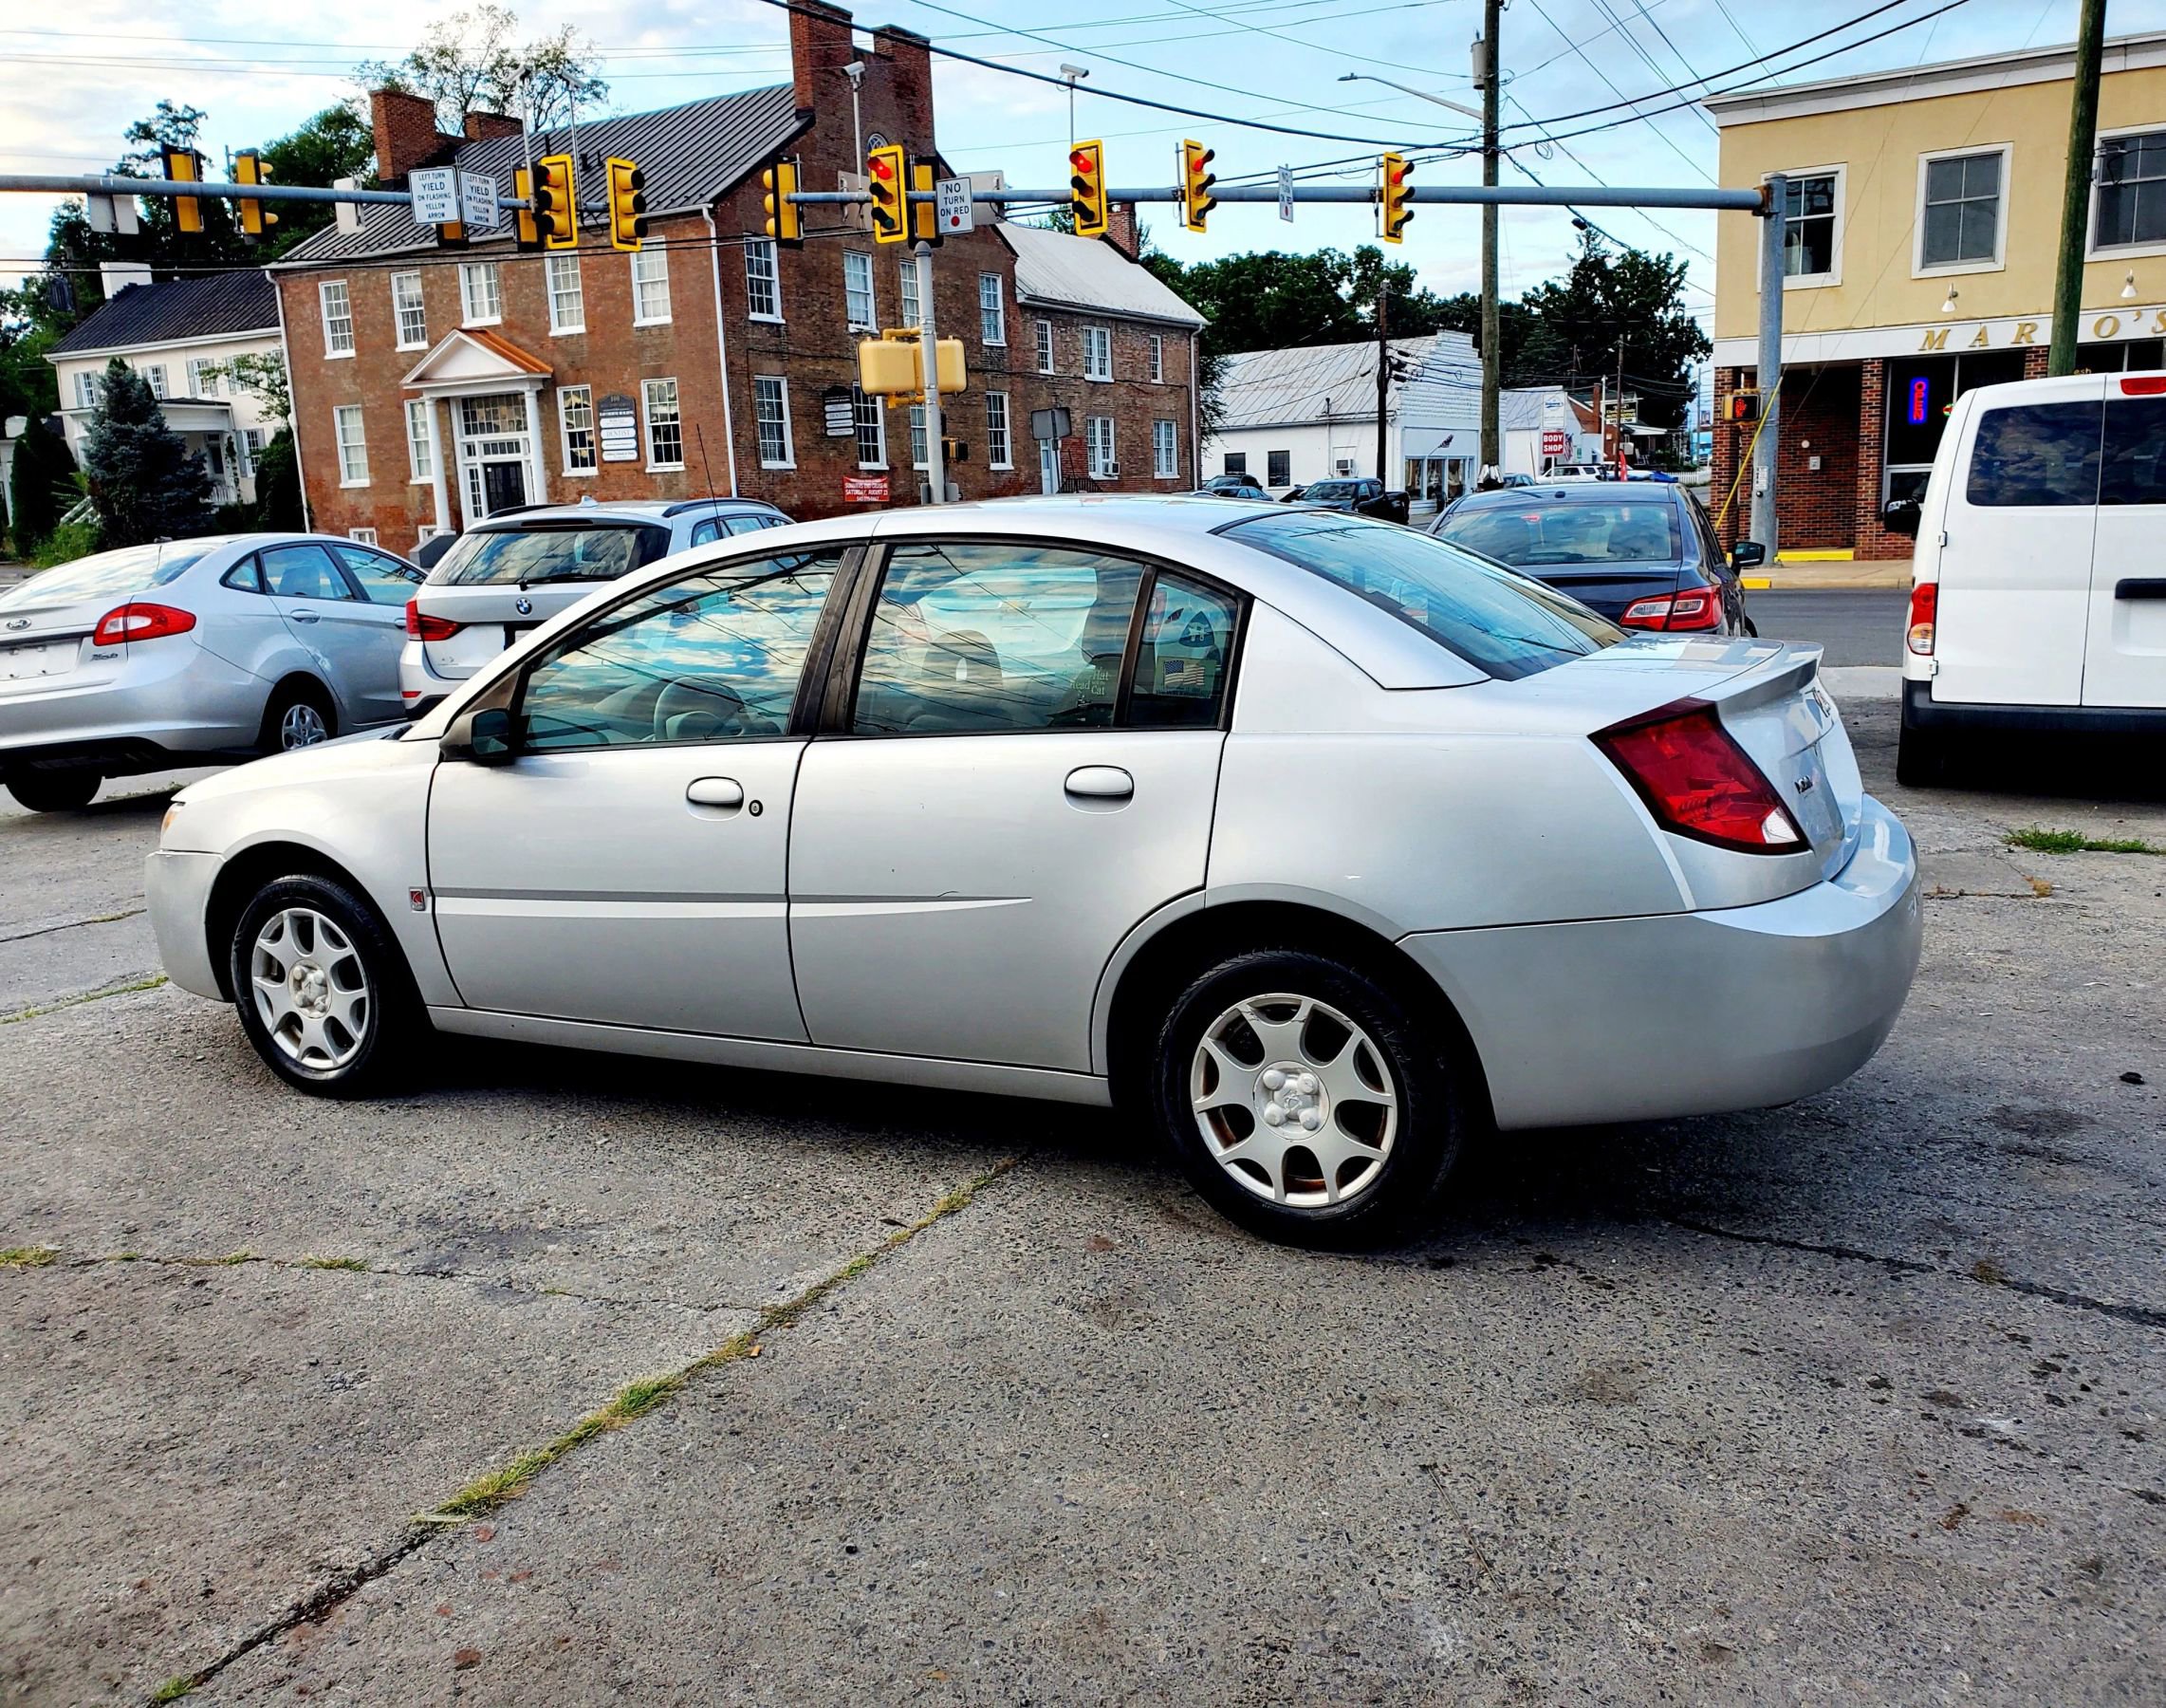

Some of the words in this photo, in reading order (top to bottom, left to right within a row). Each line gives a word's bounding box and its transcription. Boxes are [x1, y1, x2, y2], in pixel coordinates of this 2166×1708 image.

[421, 181, 445, 191] YIELD
[470, 184, 490, 195] YIELD
[945, 182, 961, 195] NO
[426, 192, 451, 200] FLASHING
[472, 196, 494, 206] FLASHING
[943, 195, 964, 205] TURN
[425, 202, 445, 211] YELLOW
[472, 205, 489, 214] YELLOW
[940, 208, 952, 217] ON
[953, 205, 970, 215] RED
[1918, 310, 2166, 351] MARO'S
[1913, 381, 1927, 420] OPEN
[606, 429, 630, 438] DENTIST
